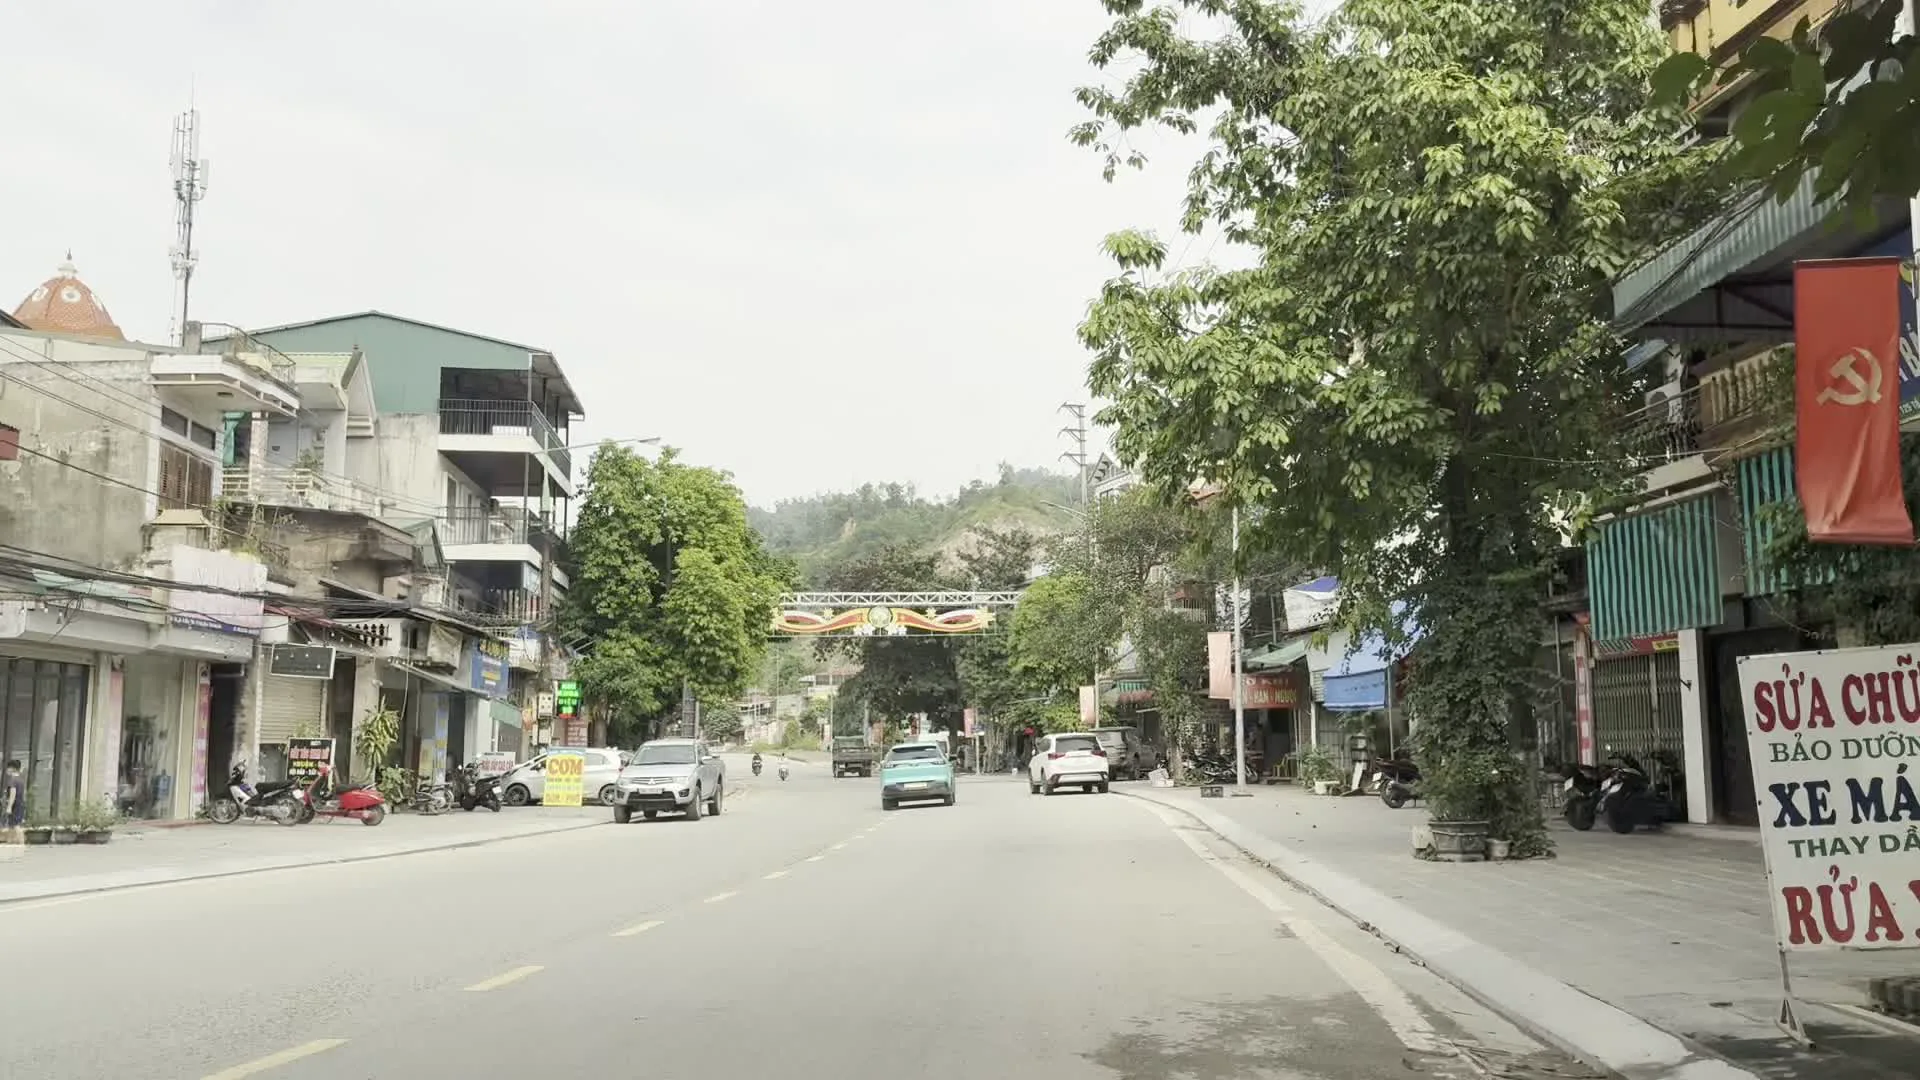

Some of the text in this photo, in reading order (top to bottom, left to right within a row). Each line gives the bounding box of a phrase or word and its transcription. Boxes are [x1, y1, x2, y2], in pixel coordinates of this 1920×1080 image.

[1754, 663, 1835, 732] SỬA
[1768, 732, 1832, 763] BẢO
[1768, 780, 1837, 828] XE
[1788, 835, 1870, 859] THAY
[1782, 864, 1904, 945] RỬA
